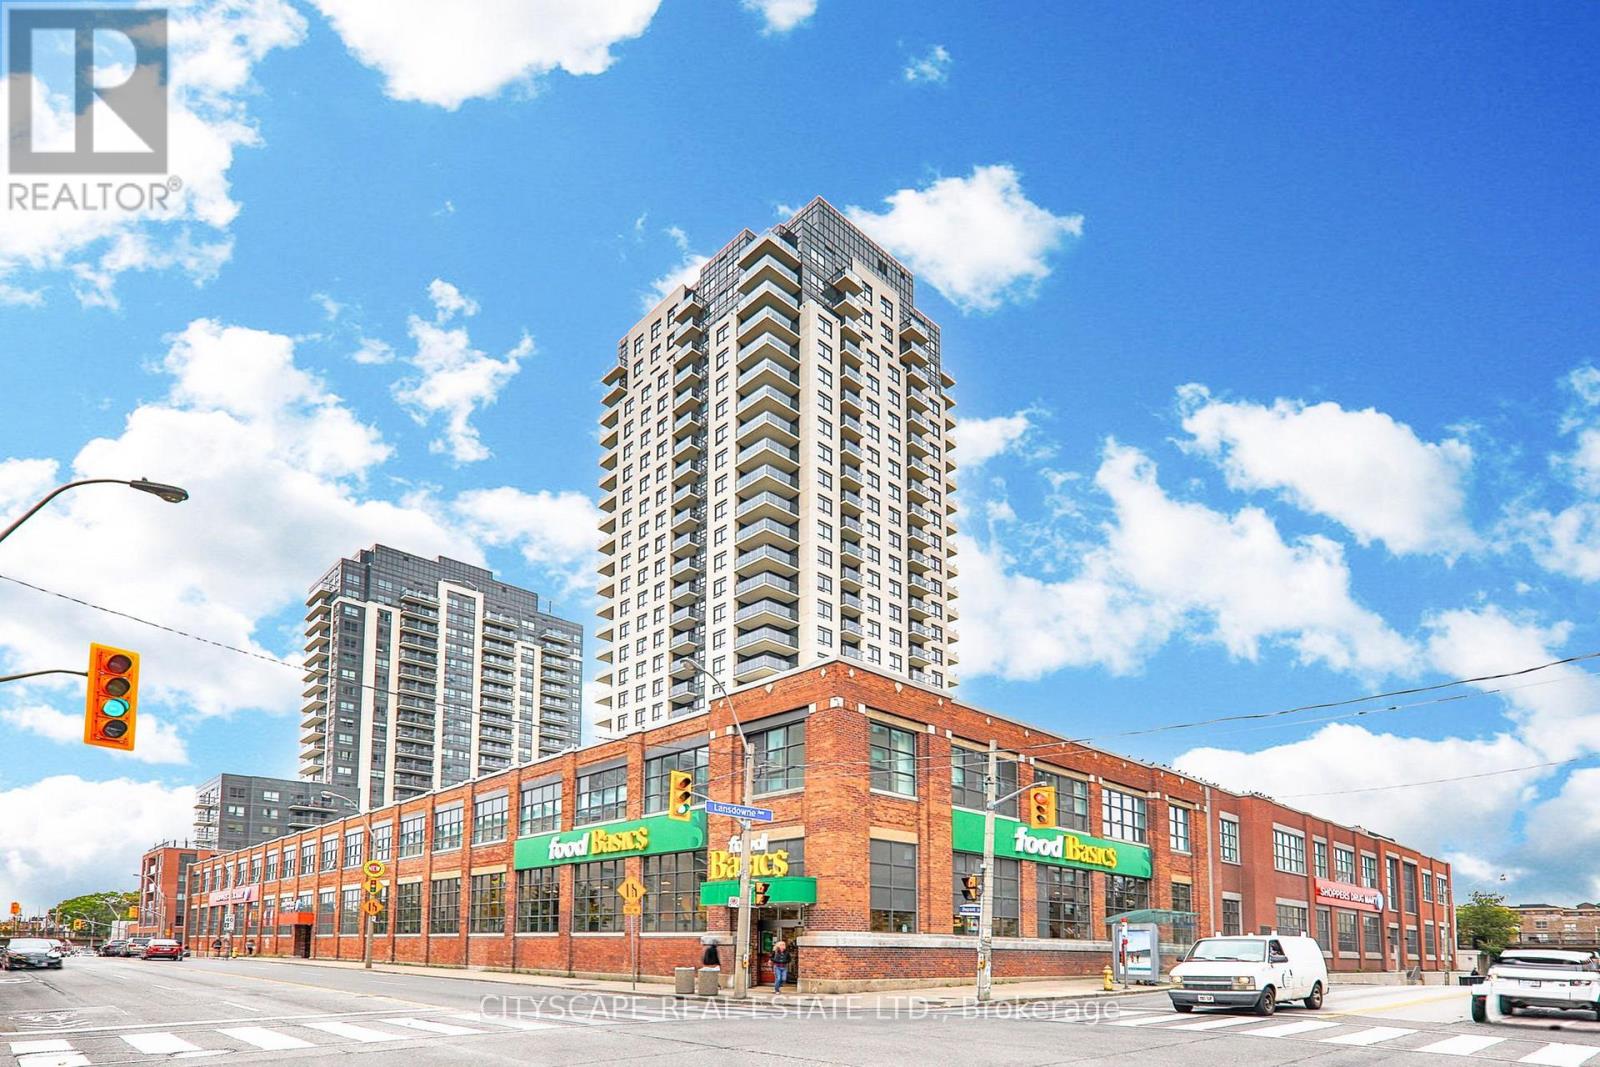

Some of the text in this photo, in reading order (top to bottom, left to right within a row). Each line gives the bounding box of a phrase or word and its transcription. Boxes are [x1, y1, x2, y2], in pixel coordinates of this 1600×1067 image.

[713, 803, 757, 818] Lansdowne
[548, 826, 648, 860] food Basics
[1013, 827, 1117, 868] food Basics
[709, 849, 789, 881] Baics
